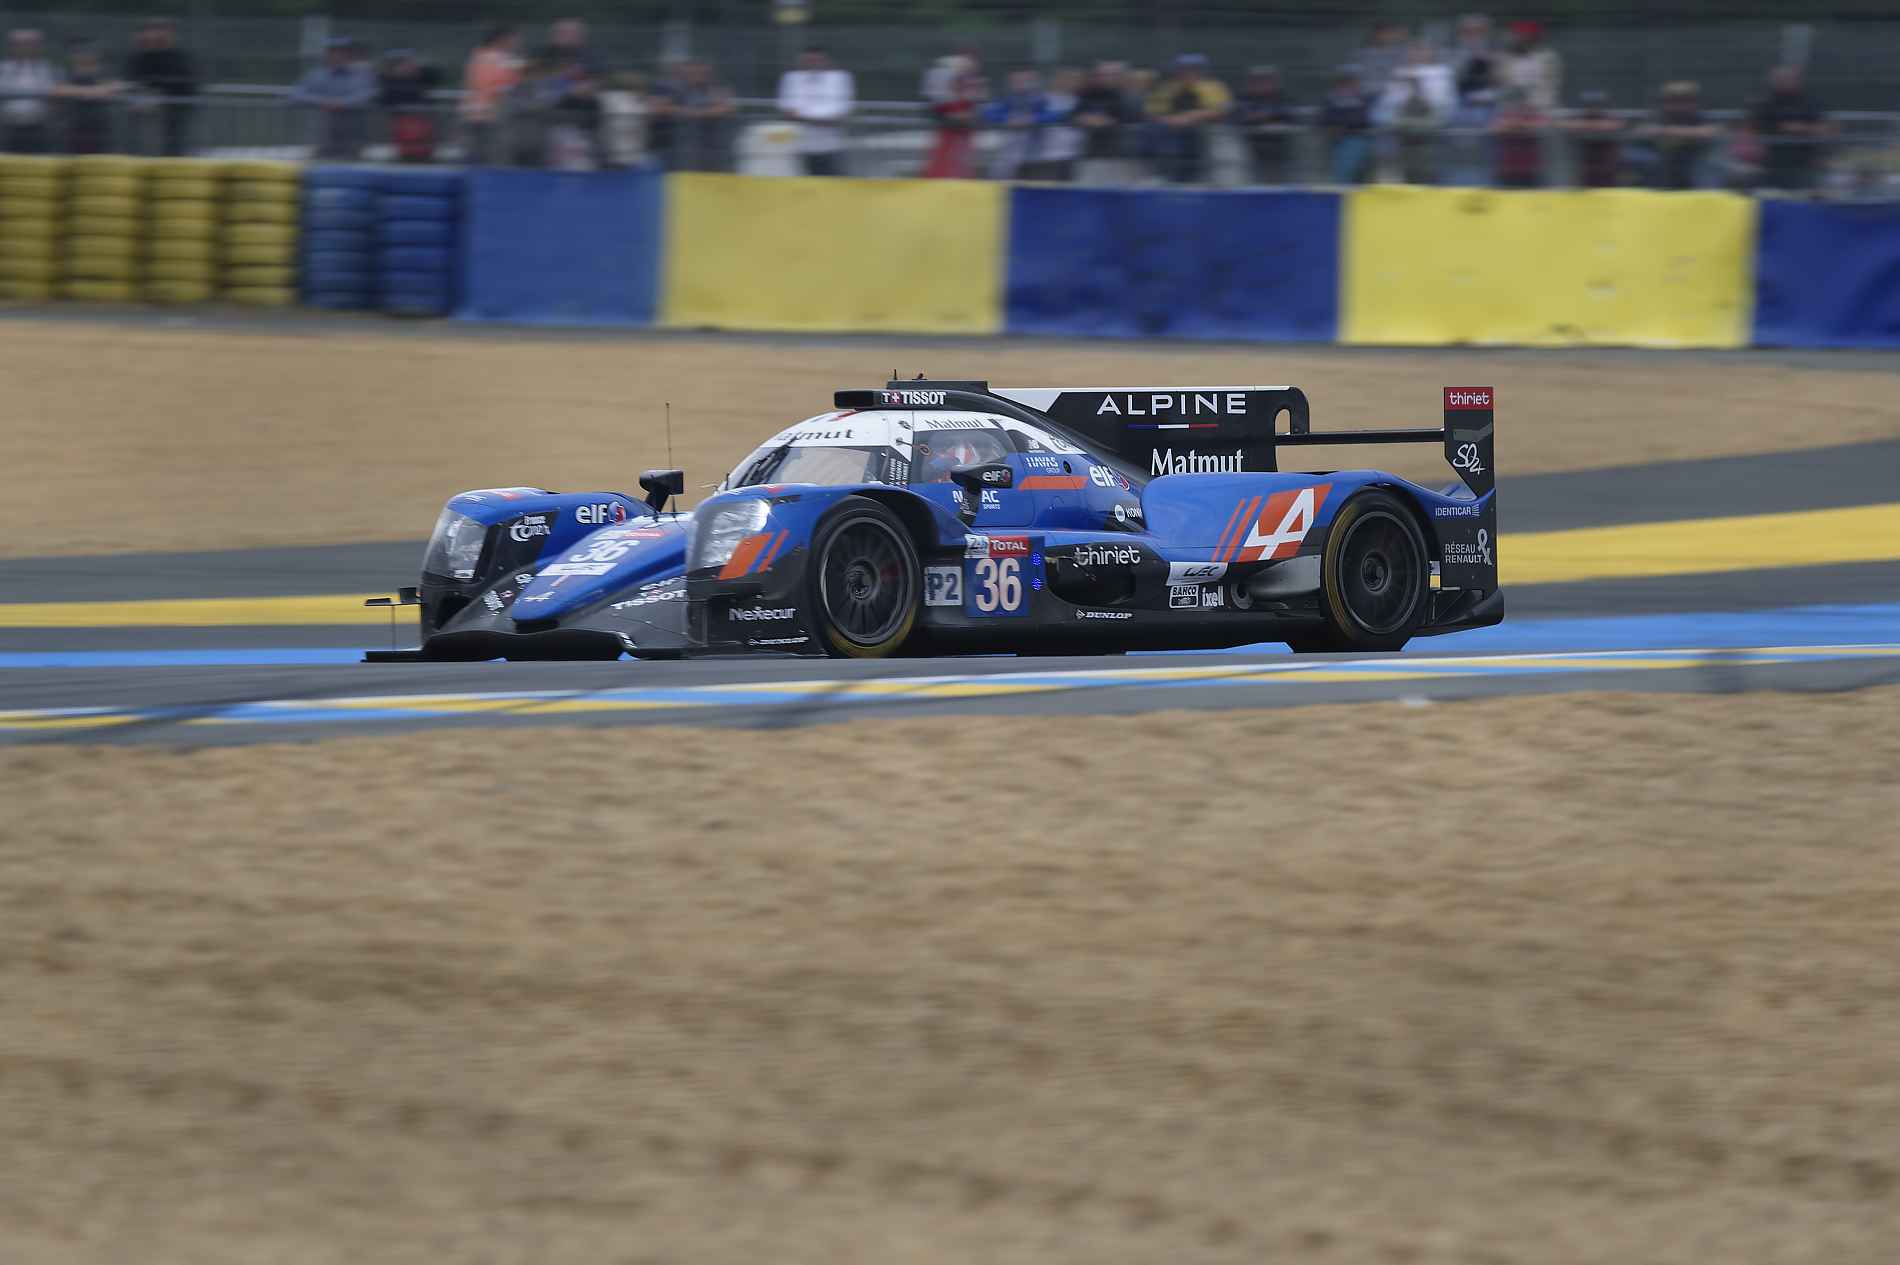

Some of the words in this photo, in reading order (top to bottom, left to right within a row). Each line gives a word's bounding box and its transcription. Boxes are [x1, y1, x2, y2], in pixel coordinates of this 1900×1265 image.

[900, 391, 947, 405] TISSOT
[1096, 393, 1247, 416] ALPINE
[1449, 391, 1490, 405] thiriet
[926, 418, 985, 431] Matmut
[1025, 456, 1059, 468] HAVAS
[1151, 448, 1244, 476] Matmut
[982, 470, 1001, 481] elf
[1089, 464, 1116, 488] elf
[575, 504, 607, 524] elf
[1435, 506, 1472, 517] IDENTICAR
[991, 540, 1028, 551] TOTAL
[1445, 541, 1476, 554] RÉSEAU
[1074, 546, 1141, 566] thiriet
[1445, 555, 1483, 564] RENAULT
[976, 558, 1022, 612] 36
[1202, 586, 1224, 607] ixell
[1085, 611, 1133, 620] DUNLOP
